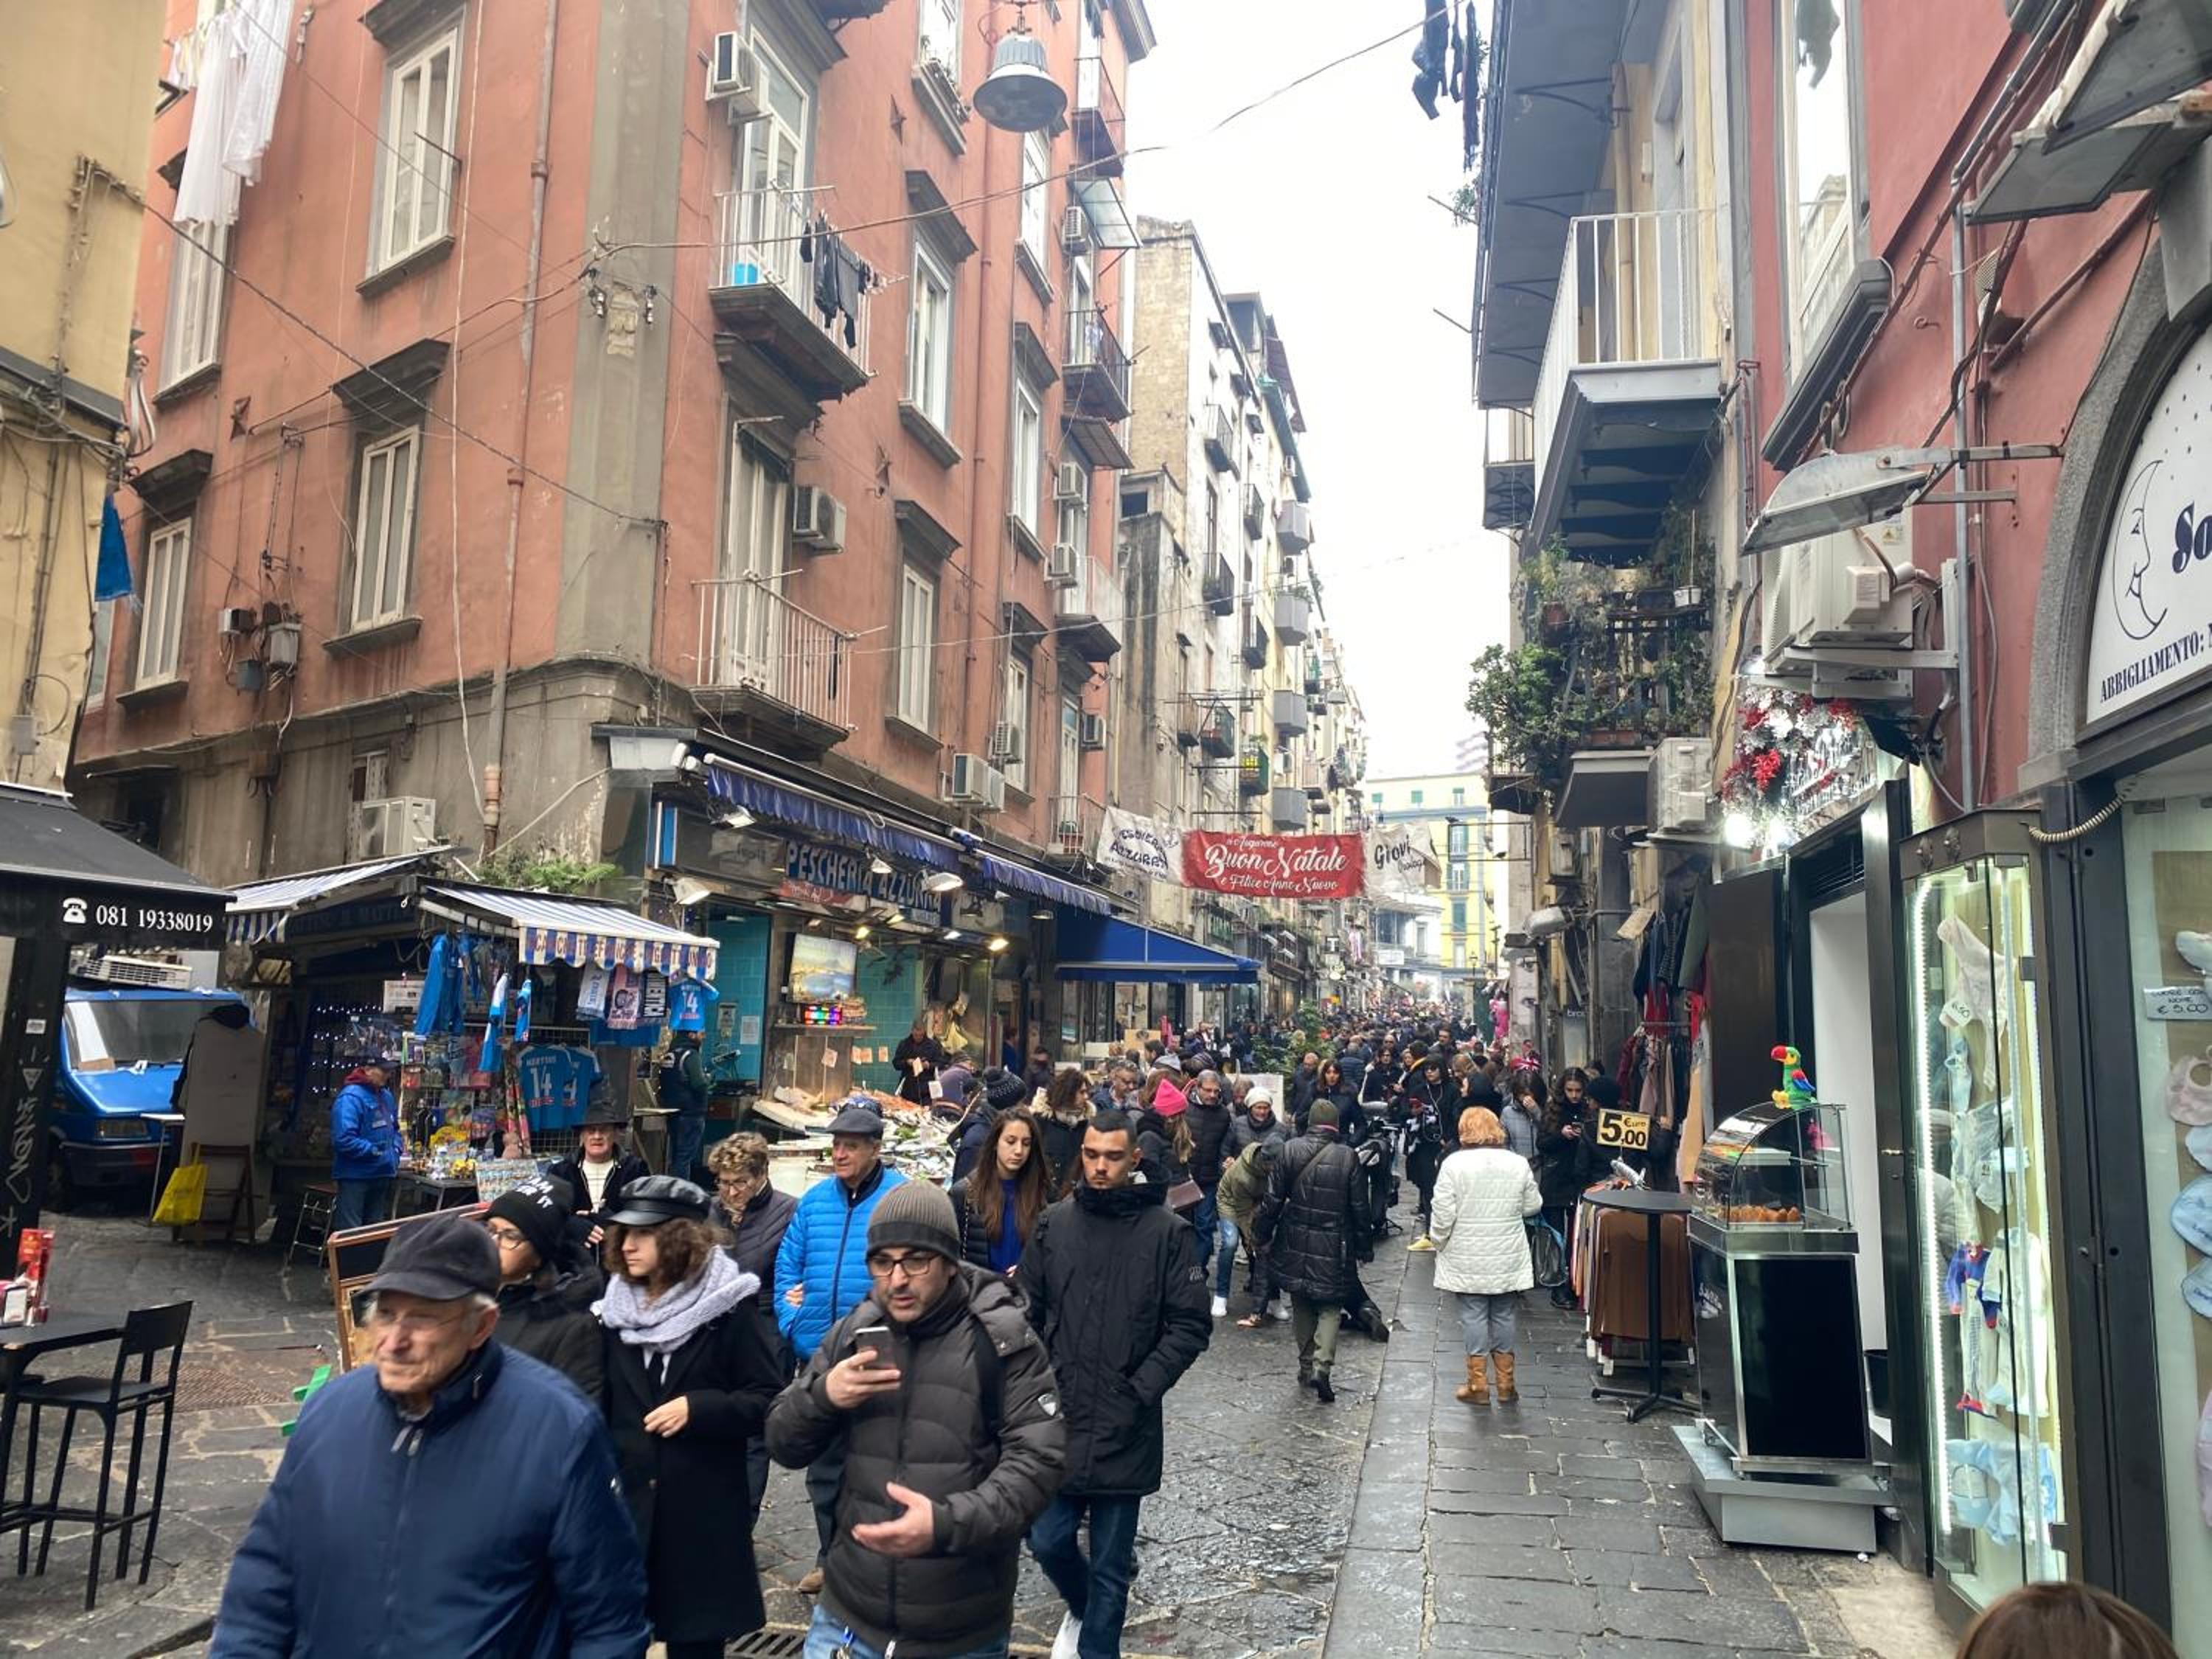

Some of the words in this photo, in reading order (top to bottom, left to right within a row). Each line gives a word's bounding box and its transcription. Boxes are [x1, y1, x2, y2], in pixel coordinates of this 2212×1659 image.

[2100, 630, 2205, 703] ABBIGLIAMENTO:
[785, 838, 872, 896] PESCHERIA
[1205, 844, 1264, 878] Buon
[1264, 845, 1349, 878] Natale
[1374, 834, 1411, 870] Giovi
[1230, 874, 1262, 891] Felice
[1263, 875, 1294, 895] Anno
[1295, 877, 1337, 894] Nuovo
[96, 905, 128, 927] 081
[138, 909, 212, 932] 19338019
[530, 1065, 553, 1099] 14
